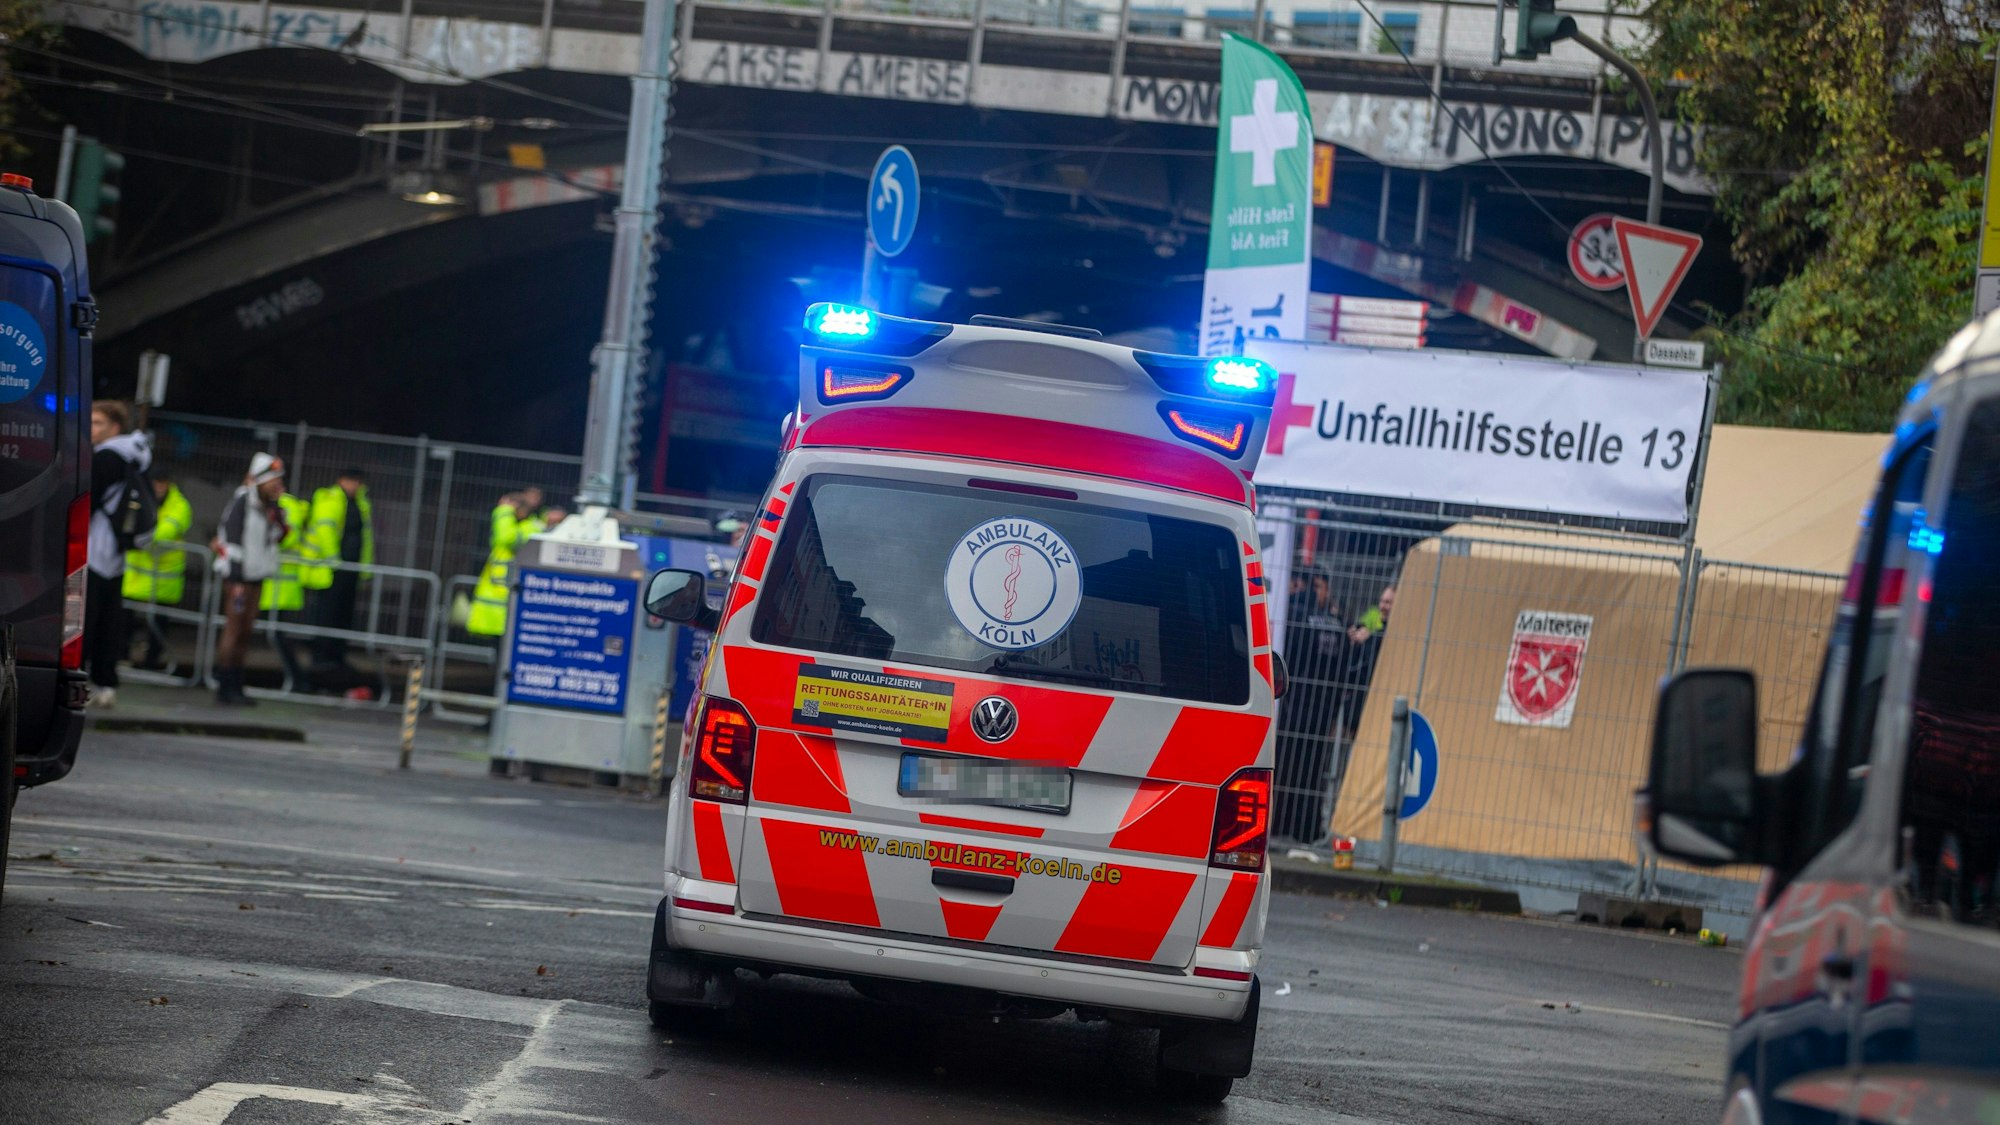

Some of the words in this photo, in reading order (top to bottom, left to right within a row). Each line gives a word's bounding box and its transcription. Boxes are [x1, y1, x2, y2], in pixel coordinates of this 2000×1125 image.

[838, 50, 966, 101] AMEISE
[1125, 78, 1221, 121] MON
[1445, 104, 1584, 160] MONO
[1315, 399, 1624, 465] Unfallhilfsstelle
[1639, 427, 1687, 471] 13
[966, 523, 1072, 569] AMBULANZ
[979, 622, 1036, 646] KÖLN
[1517, 615, 1591, 636] Malteser
[830, 669, 849, 680] WIR
[850, 672, 922, 690] QUALIFIZIEREN
[822, 700, 840, 708] OHNE
[840, 703, 864, 712] KOSTEN,
[878, 708, 922, 719] JOBGARANTIE!
[837, 719, 903, 733] www.ambulanz-koeln.de
[819, 829, 1123, 885] www.ambulanz-koeln.de
